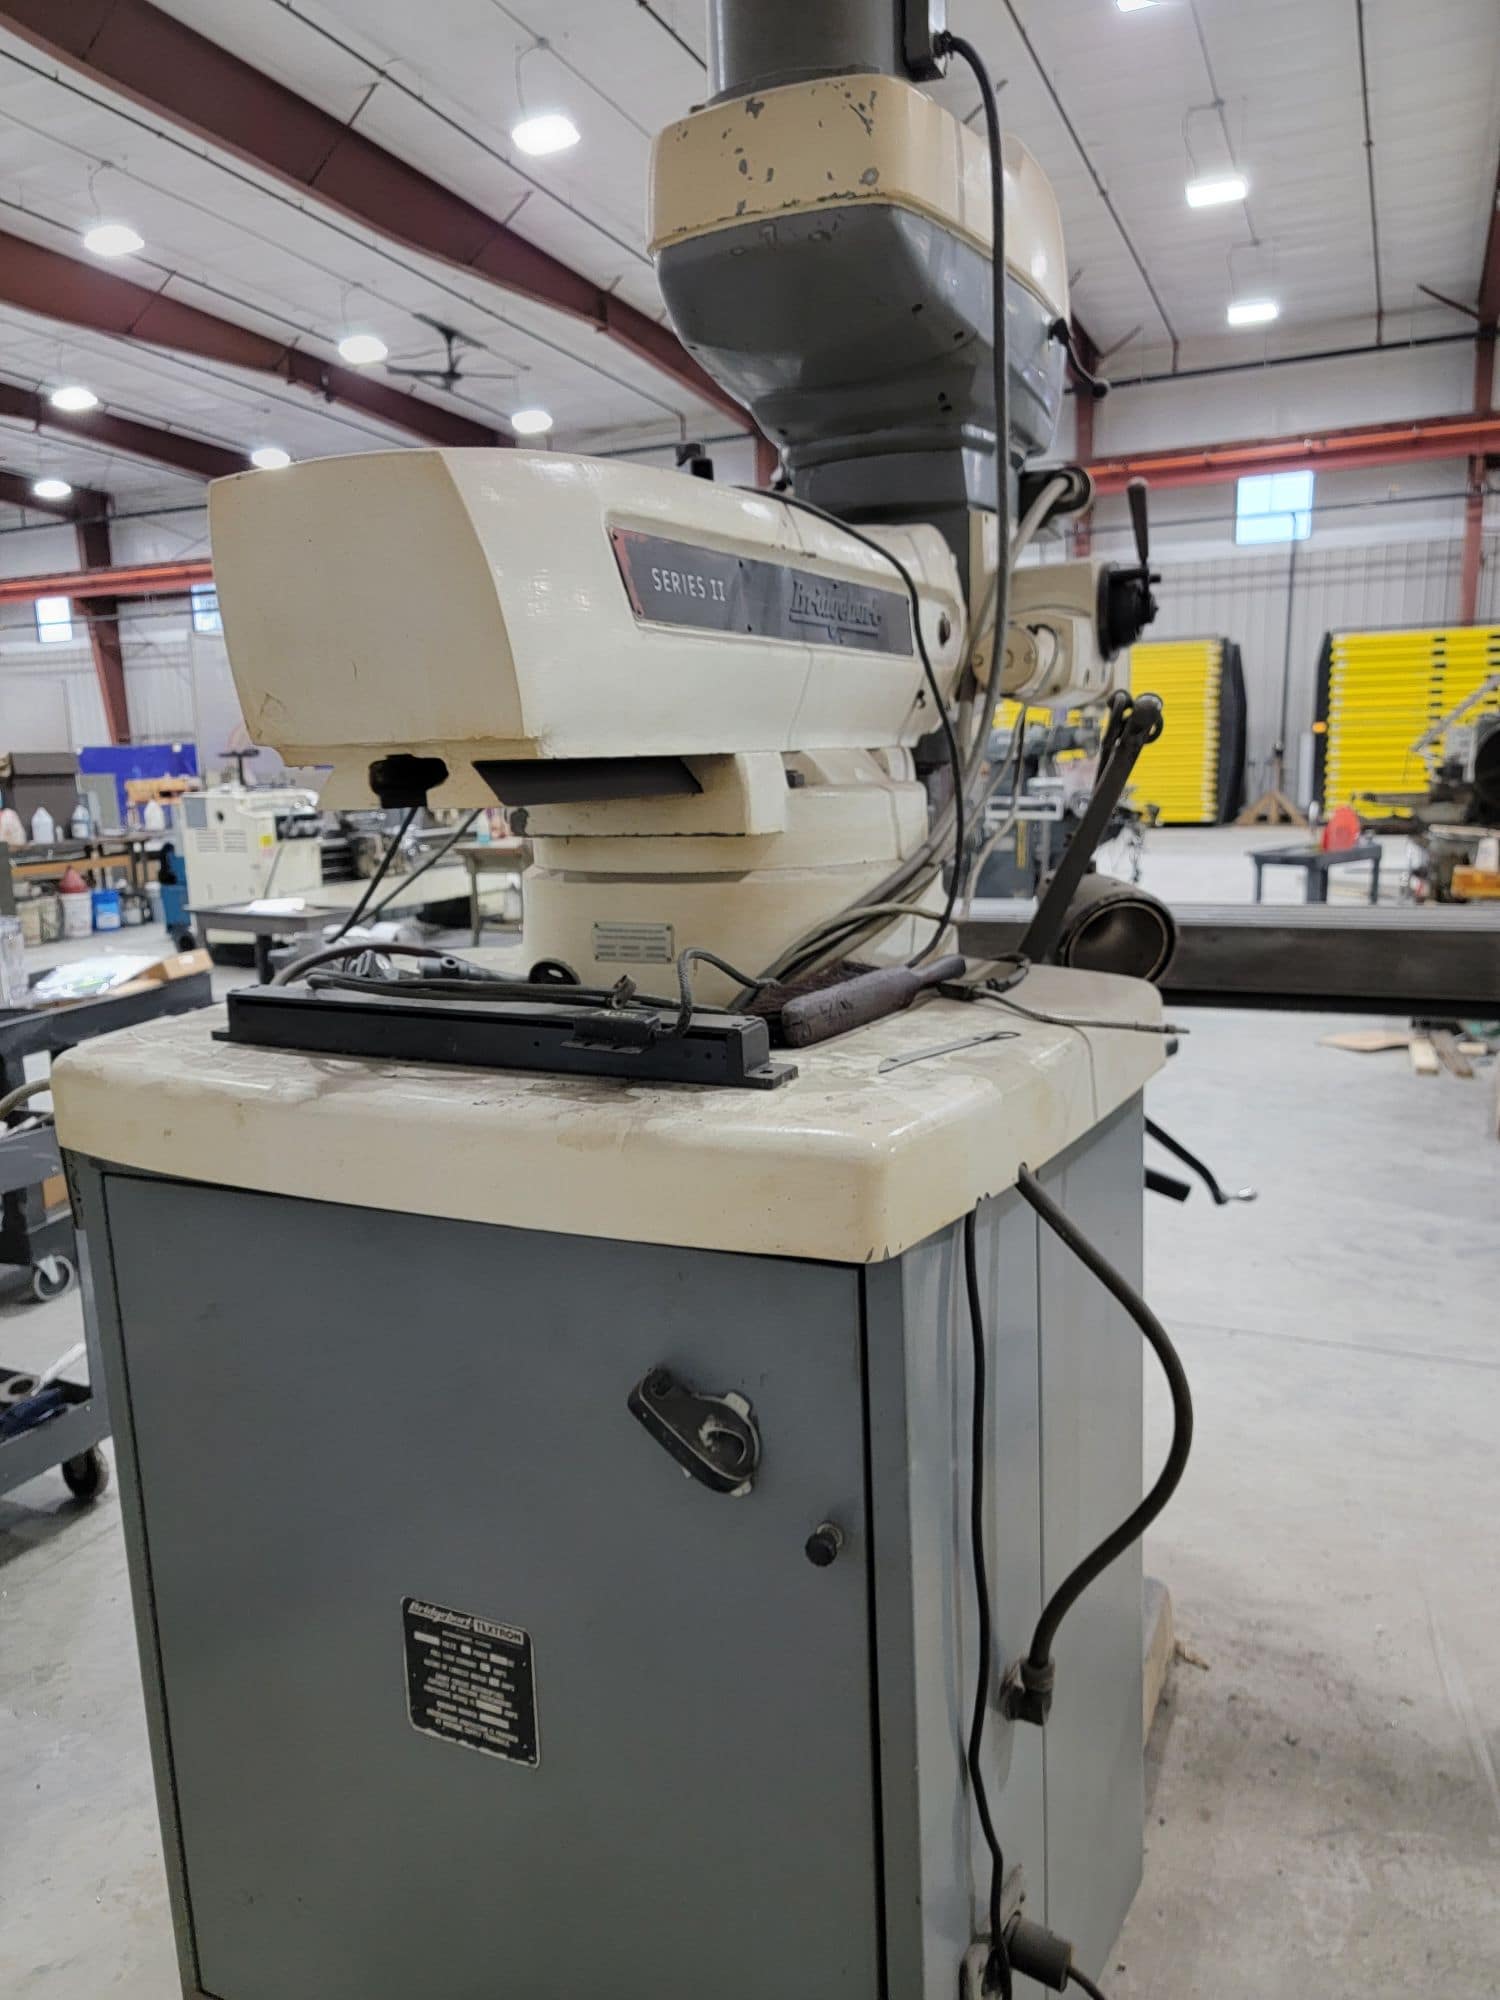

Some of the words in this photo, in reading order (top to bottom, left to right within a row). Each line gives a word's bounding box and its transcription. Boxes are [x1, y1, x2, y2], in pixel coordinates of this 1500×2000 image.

[651, 567, 705, 598] SERIES
[710, 578, 725, 601] II
[407, 1600, 472, 1630] Bridgeport
[476, 1620, 522, 1643] TEXTRON
